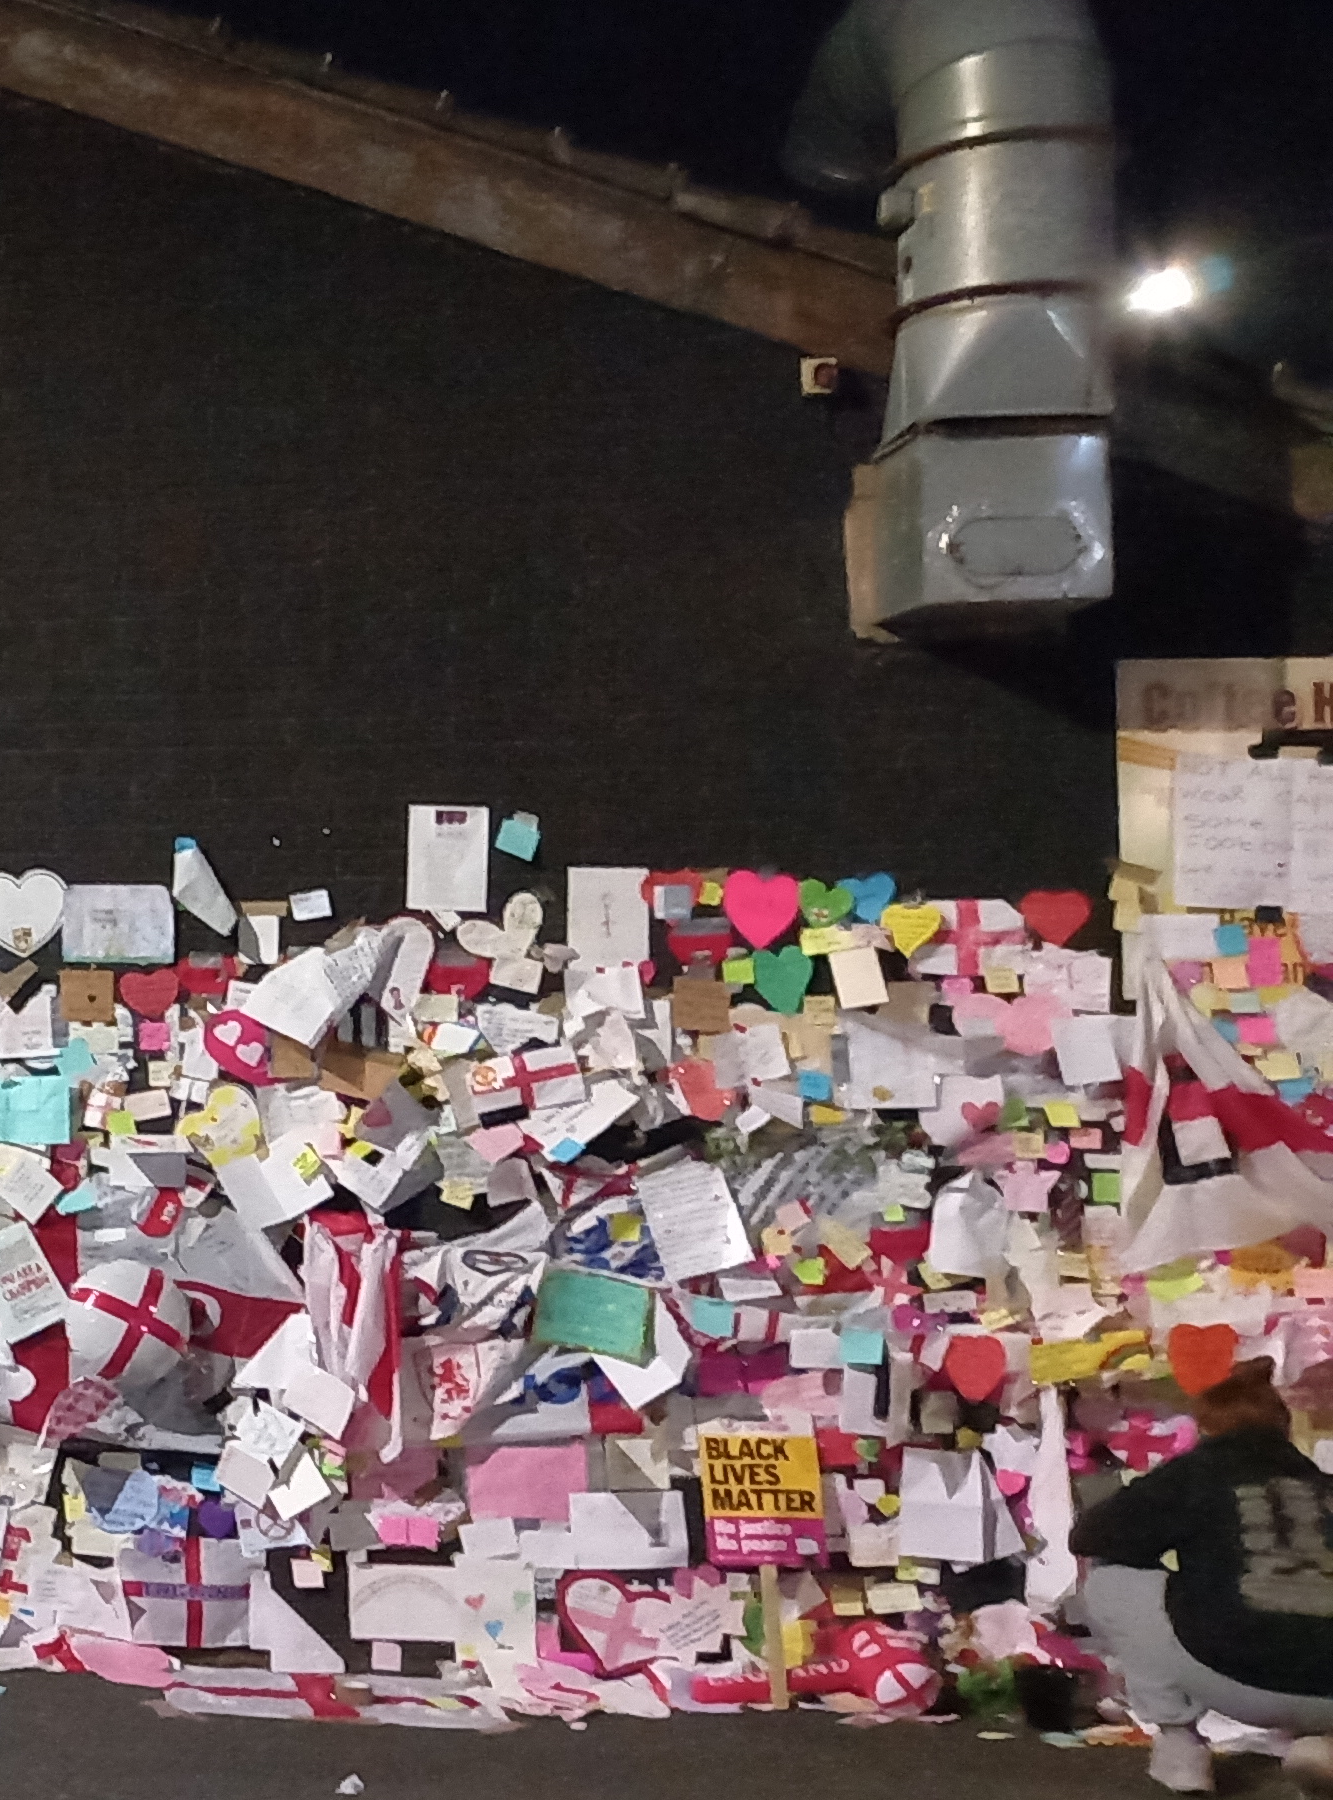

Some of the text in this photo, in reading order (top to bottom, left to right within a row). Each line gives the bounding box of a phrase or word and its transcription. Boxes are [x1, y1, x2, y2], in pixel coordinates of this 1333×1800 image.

[704, 1437, 790, 1461] BLACK
[708, 1463, 781, 1486] LIVES
[711, 1488, 816, 1512] MATTER
